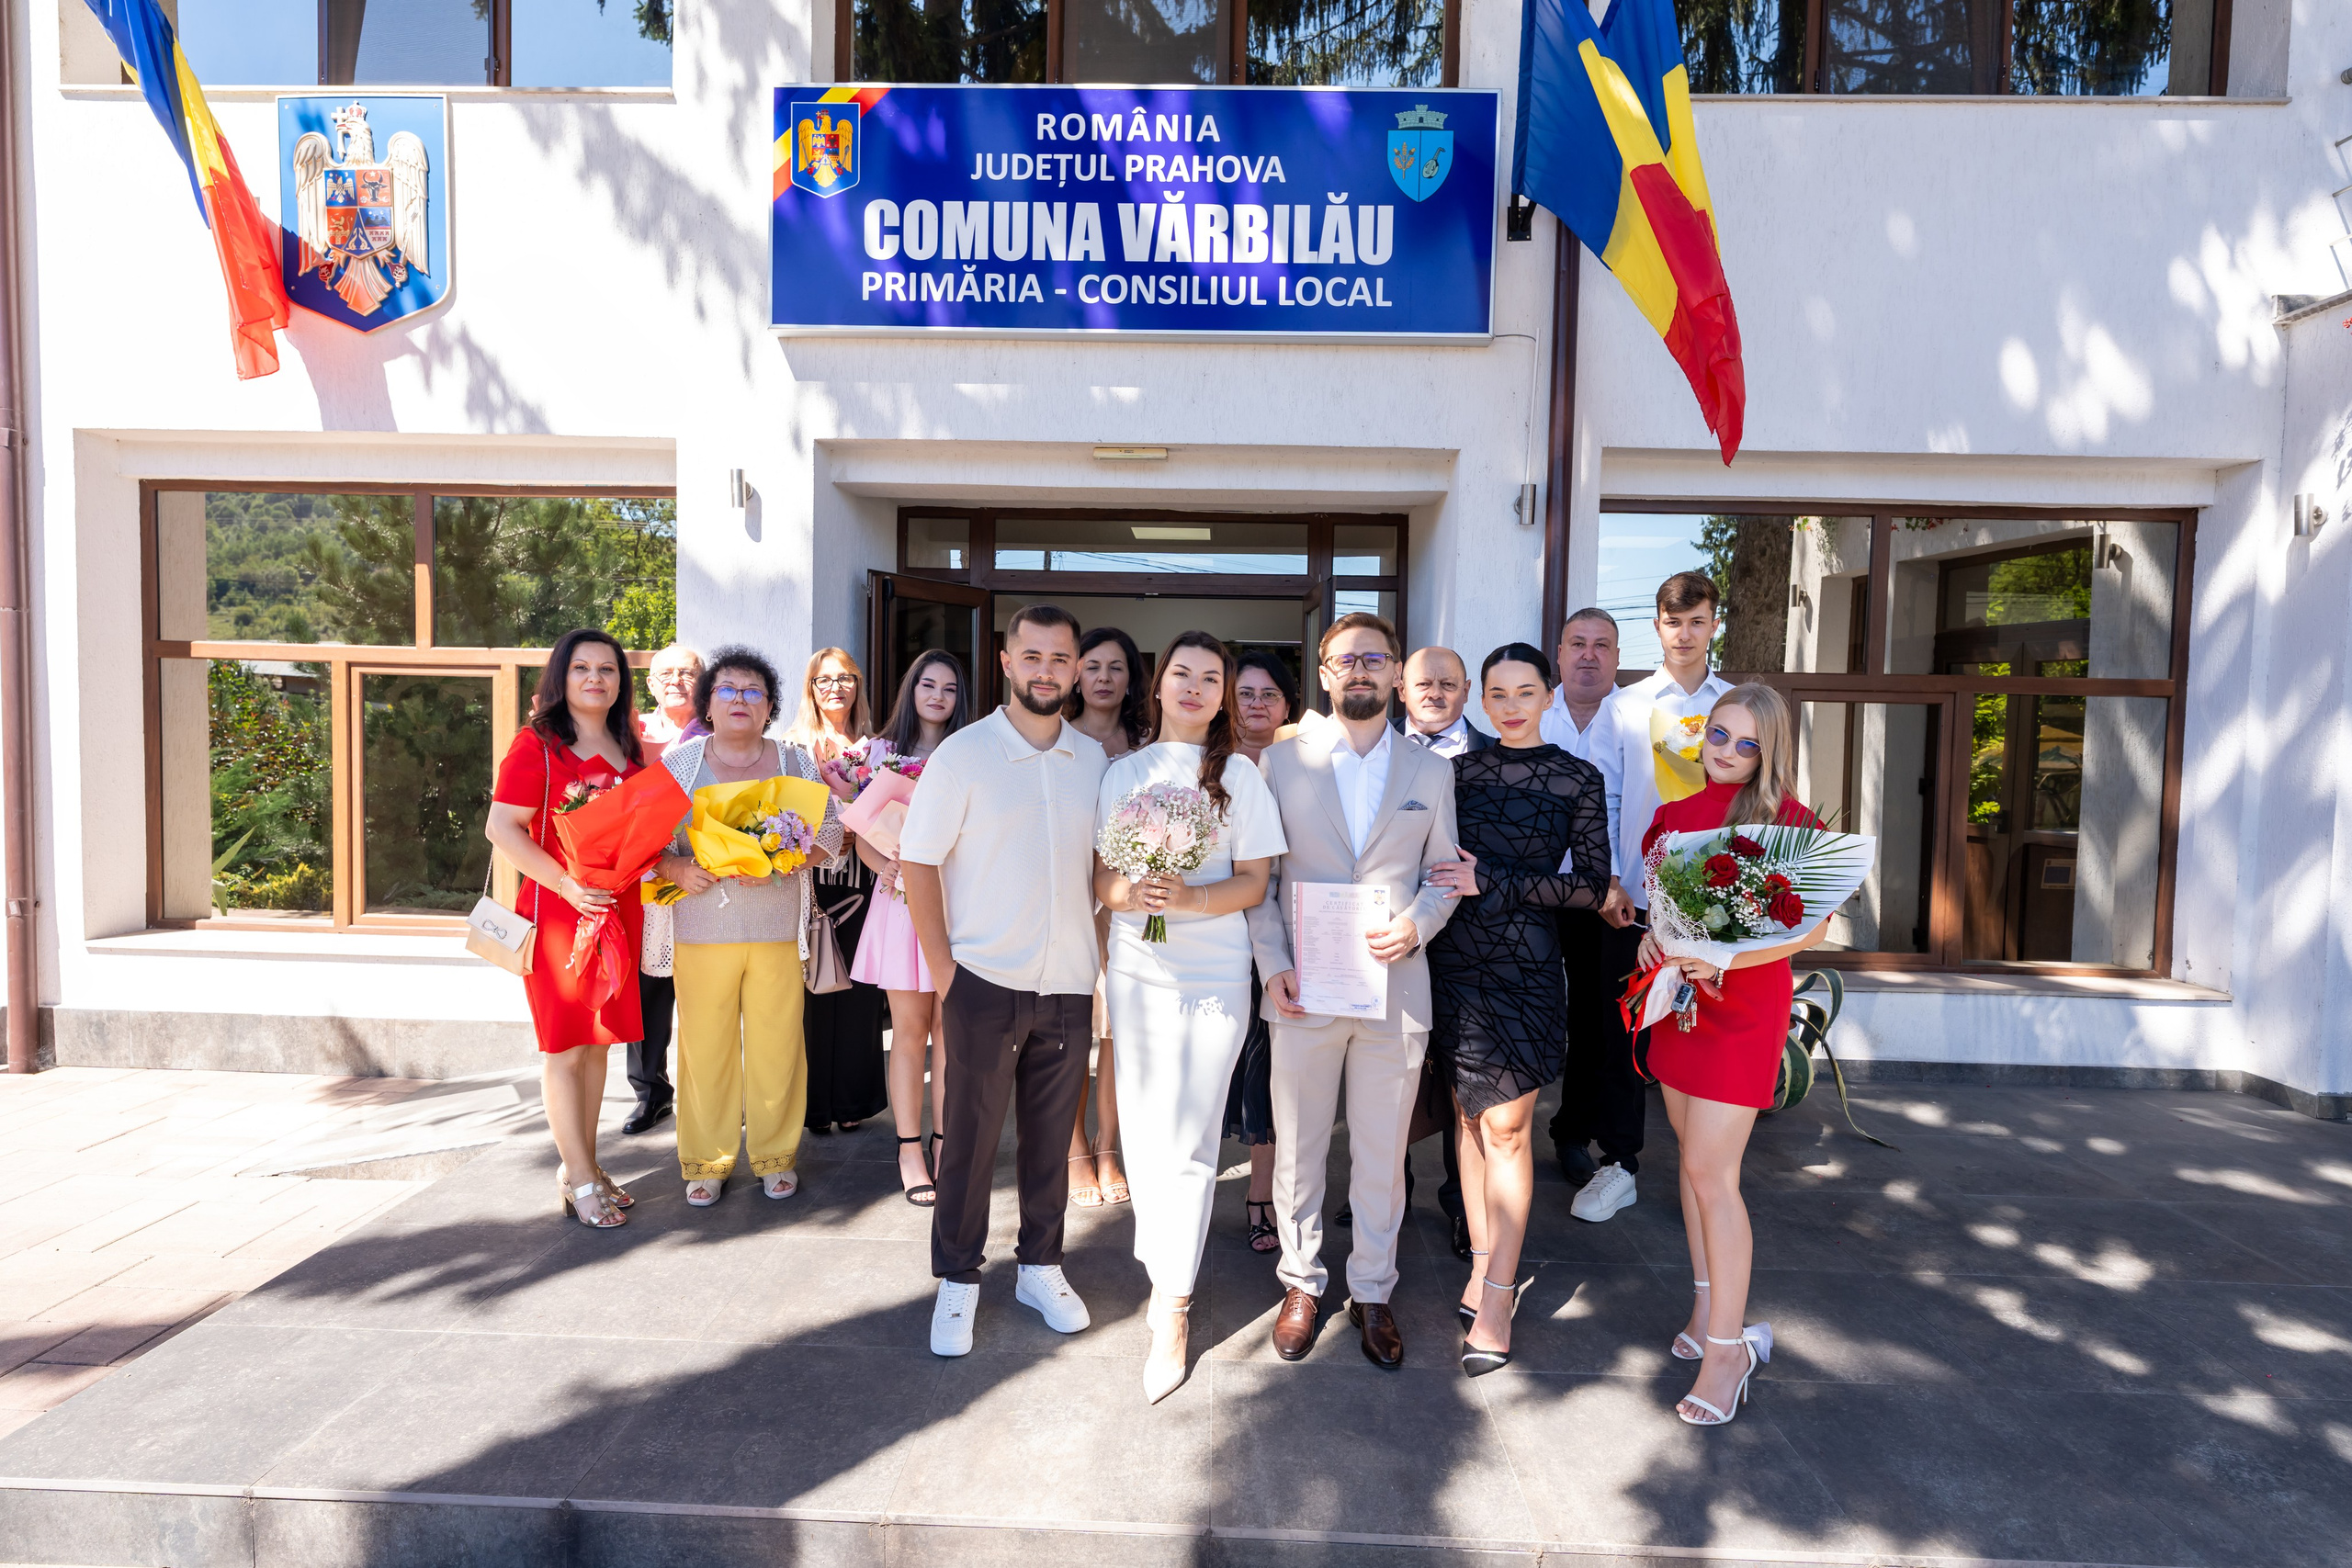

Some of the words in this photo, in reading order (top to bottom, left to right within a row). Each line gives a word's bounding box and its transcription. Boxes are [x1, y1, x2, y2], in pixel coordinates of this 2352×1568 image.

[1037, 106, 1221, 142] ROMÂNIA
[970, 152, 1115, 188] JUDEȚUL
[1125, 154, 1286, 184] PRAHOVA
[864, 198, 1106, 262] COMUNA
[1117, 189, 1394, 265] VĂRBILĂU
[862, 264, 1045, 303] PRIMĂRIA
[1078, 274, 1267, 306] CONSILIUL
[1278, 276, 1393, 307] LOCAL
